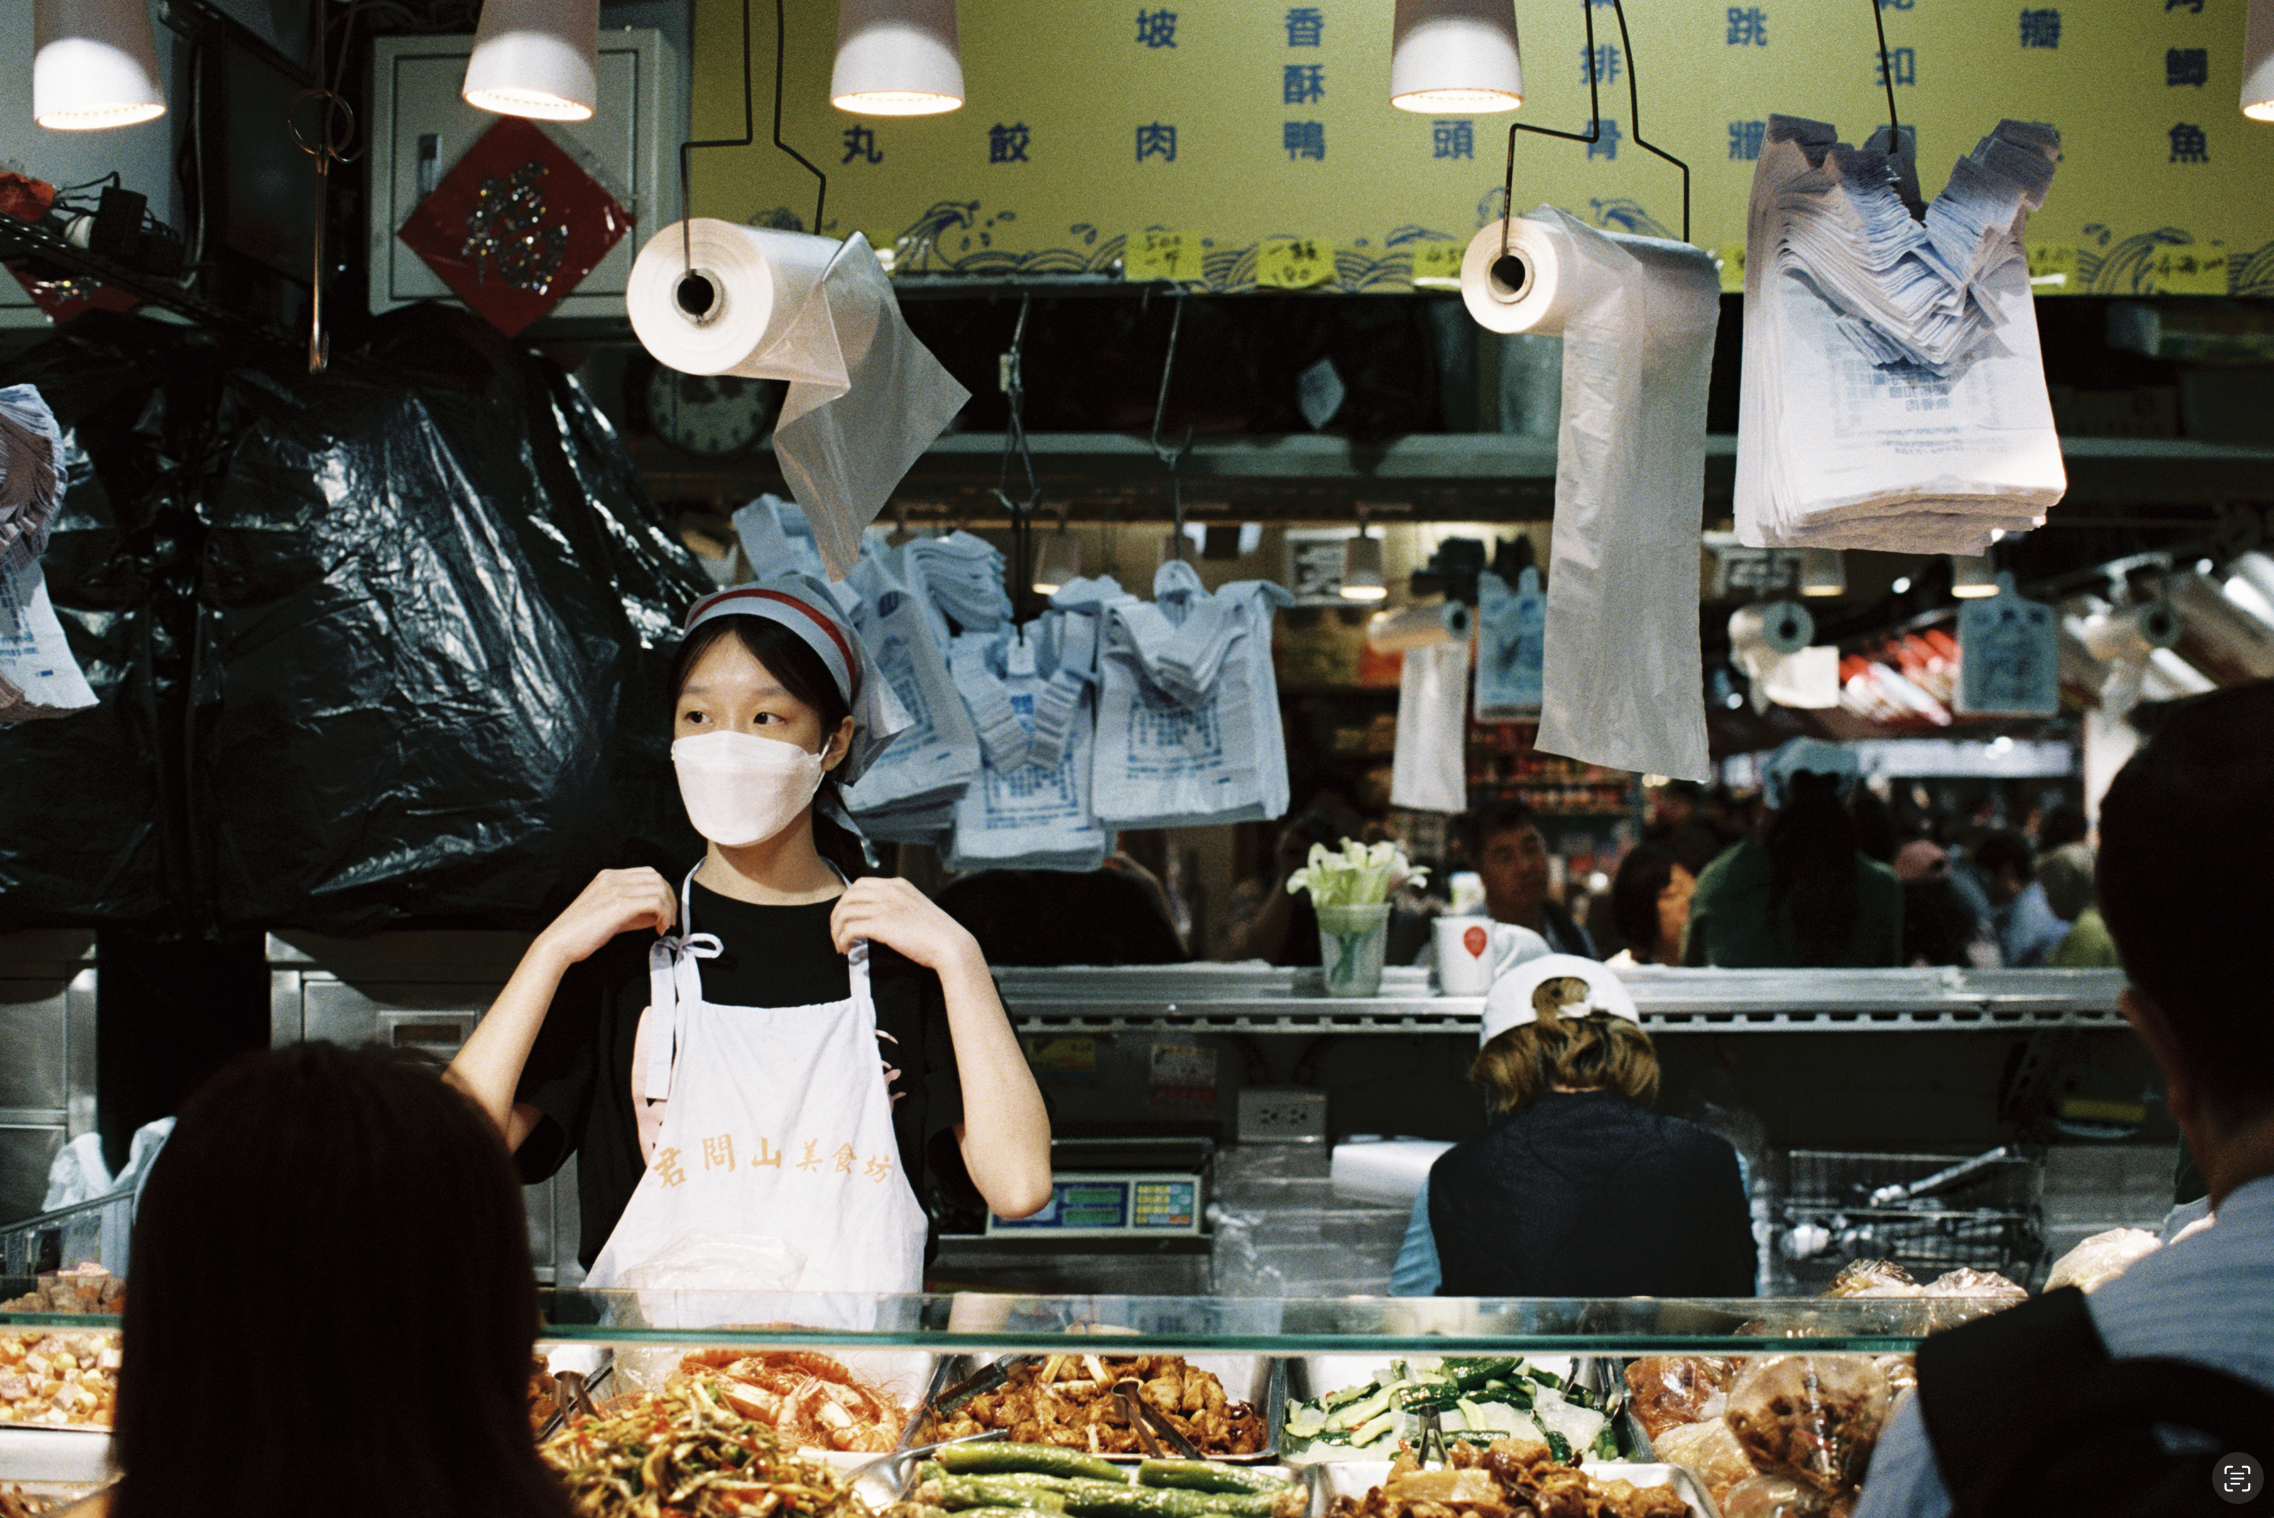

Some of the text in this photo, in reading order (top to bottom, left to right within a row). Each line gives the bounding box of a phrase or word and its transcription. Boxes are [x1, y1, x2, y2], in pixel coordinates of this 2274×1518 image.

[1135, 8, 1177, 163] 坡肉
[1282, 7, 1326, 161] 香酥鴨
[1581, 0, 1622, 161] 排骨
[842, 124, 883, 165] 丸
[988, 122, 1030, 164] 餃
[1432, 119, 1475, 160] 頭
